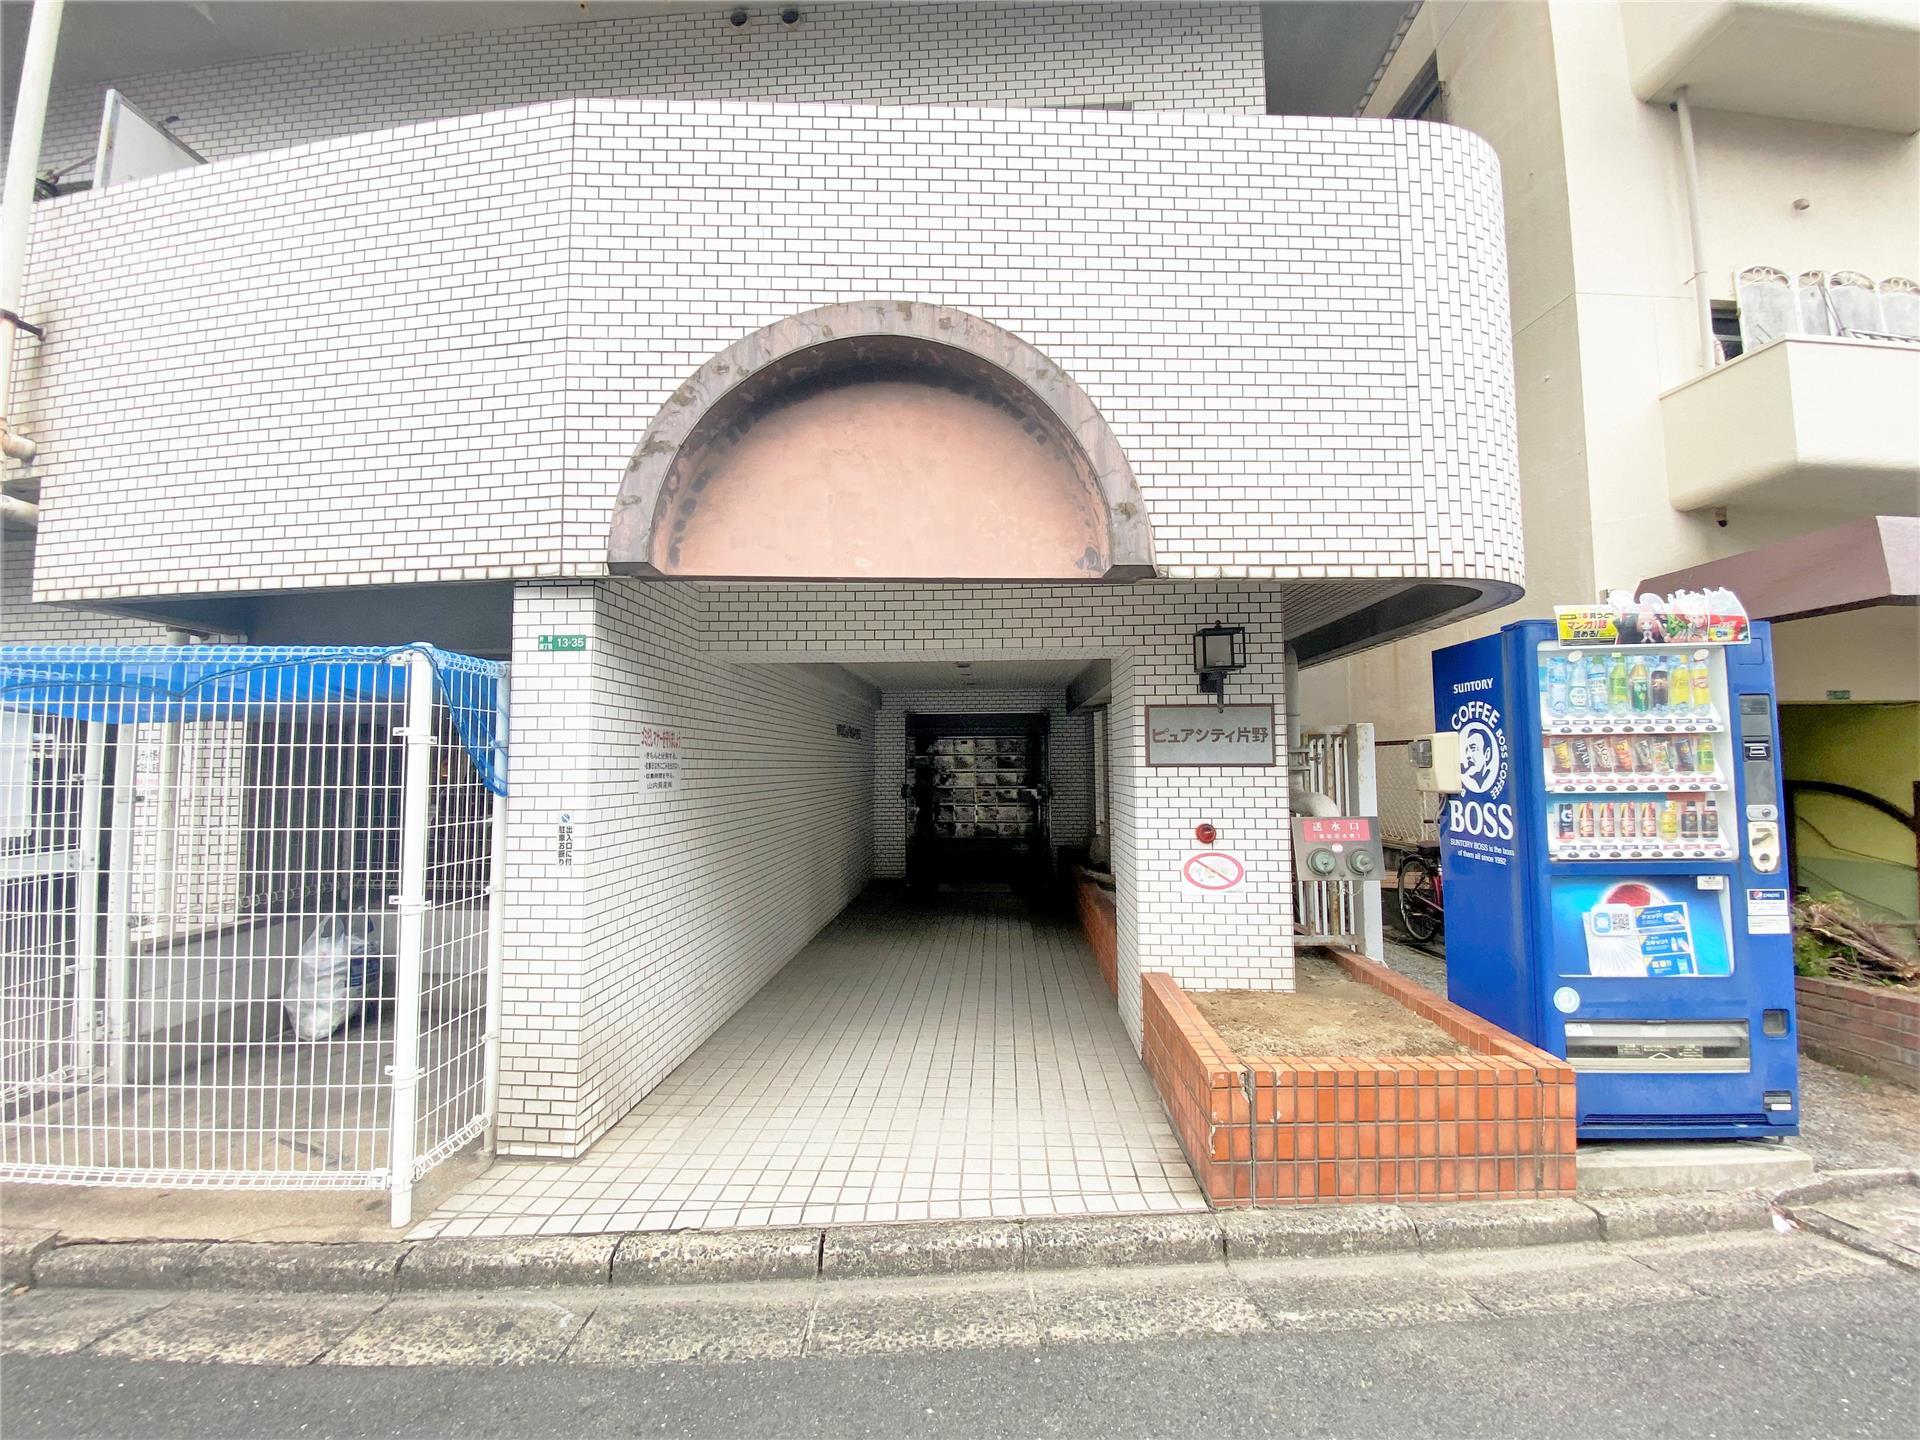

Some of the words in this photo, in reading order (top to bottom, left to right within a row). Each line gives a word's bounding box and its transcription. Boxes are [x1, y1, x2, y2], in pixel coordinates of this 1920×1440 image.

[557, 637, 584, 648] 13-35
[1453, 677, 1494, 694] SUNTORY
[1451, 701, 1501, 730] COFFEE
[1152, 727, 1269, 743] ピュアシティ片野
[1495, 728, 1509, 759] BOSS
[1490, 762, 1508, 800] COFFEE
[1312, 822, 1359, 832] 送水口
[1448, 800, 1514, 840] BOSS
[565, 825, 573, 866] 出入口に付
[1450, 838, 1473, 849] SUNTORY
[1474, 842, 1489, 852] BOSS
[1494, 846, 1502, 854] the
[1463, 850, 1474, 859] them
